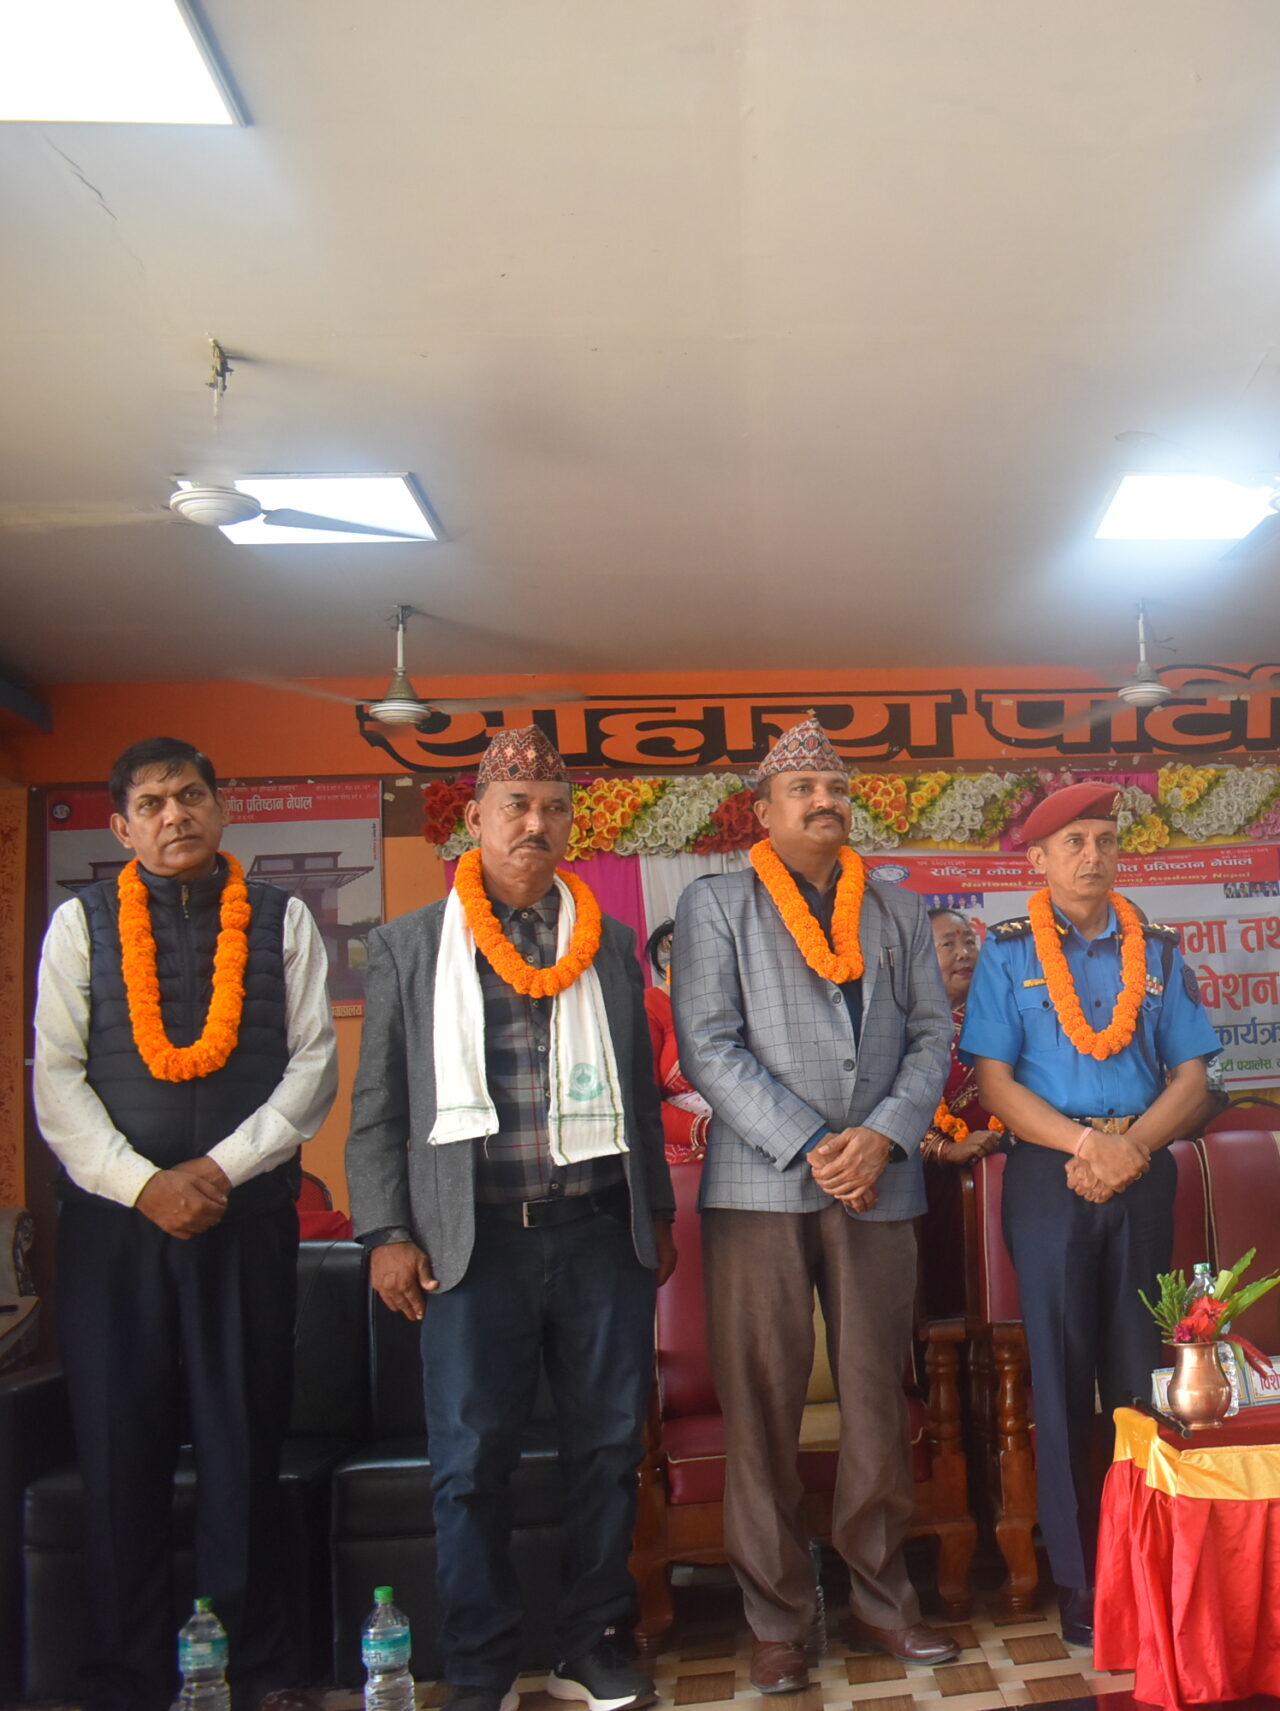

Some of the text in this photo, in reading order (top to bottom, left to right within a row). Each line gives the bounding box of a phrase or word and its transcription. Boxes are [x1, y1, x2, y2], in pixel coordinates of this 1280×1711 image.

[287, 793, 312, 810] नेपाल
[987, 866, 1022, 876] लोक
[1211, 857, 1252, 868] नेपाल
[1197, 964, 1280, 1011] वेशन
